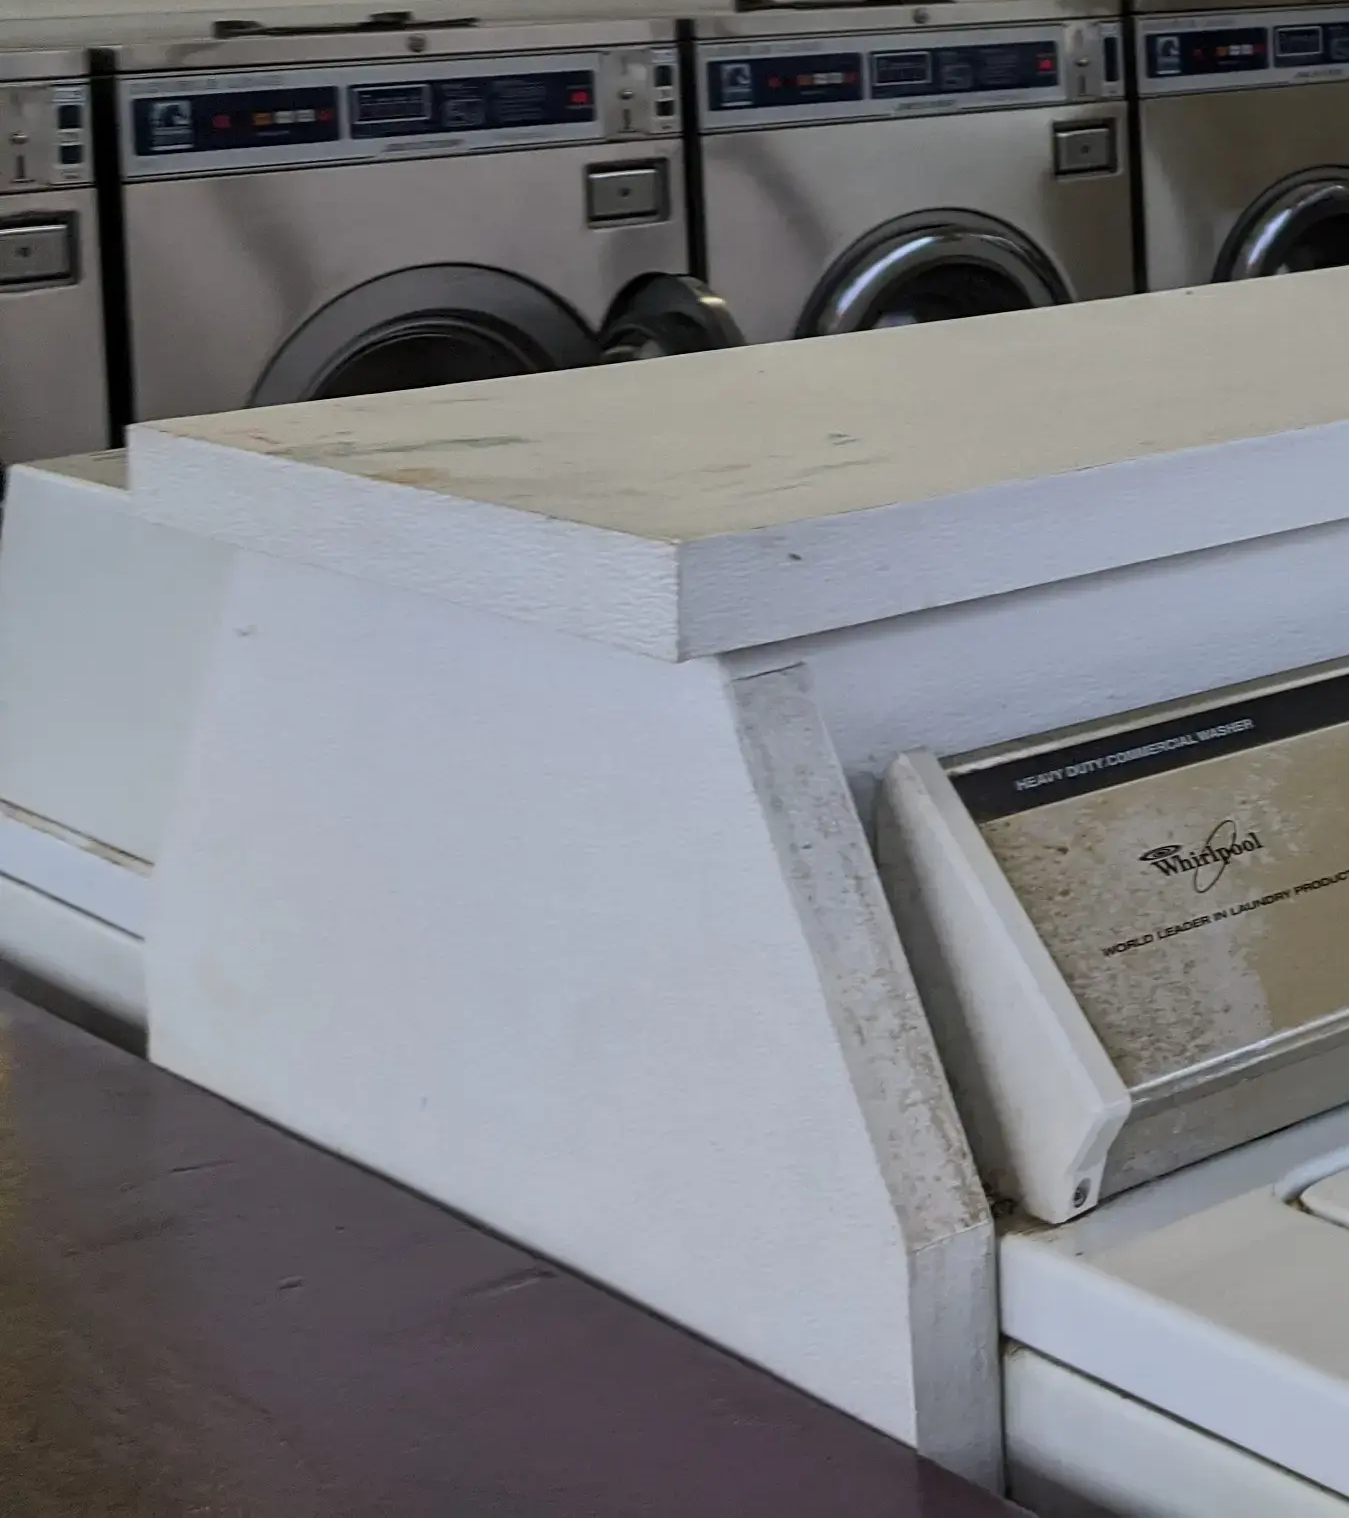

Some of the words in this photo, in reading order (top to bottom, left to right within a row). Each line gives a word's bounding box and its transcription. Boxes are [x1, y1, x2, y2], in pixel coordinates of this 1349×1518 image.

[1015, 768, 1064, 791] HEAVY
[1066, 757, 1106, 778] DUTY
[1107, 734, 1199, 767] COMMERCIAL
[1197, 718, 1254, 742] WASHER
[1151, 832, 1264, 877] Whirlpool
[1101, 934, 1154, 957] WORLD
[1156, 915, 1212, 940] LEADER
[1213, 910, 1228, 922] IN
[1229, 889, 1291, 917] LAUNDRY
